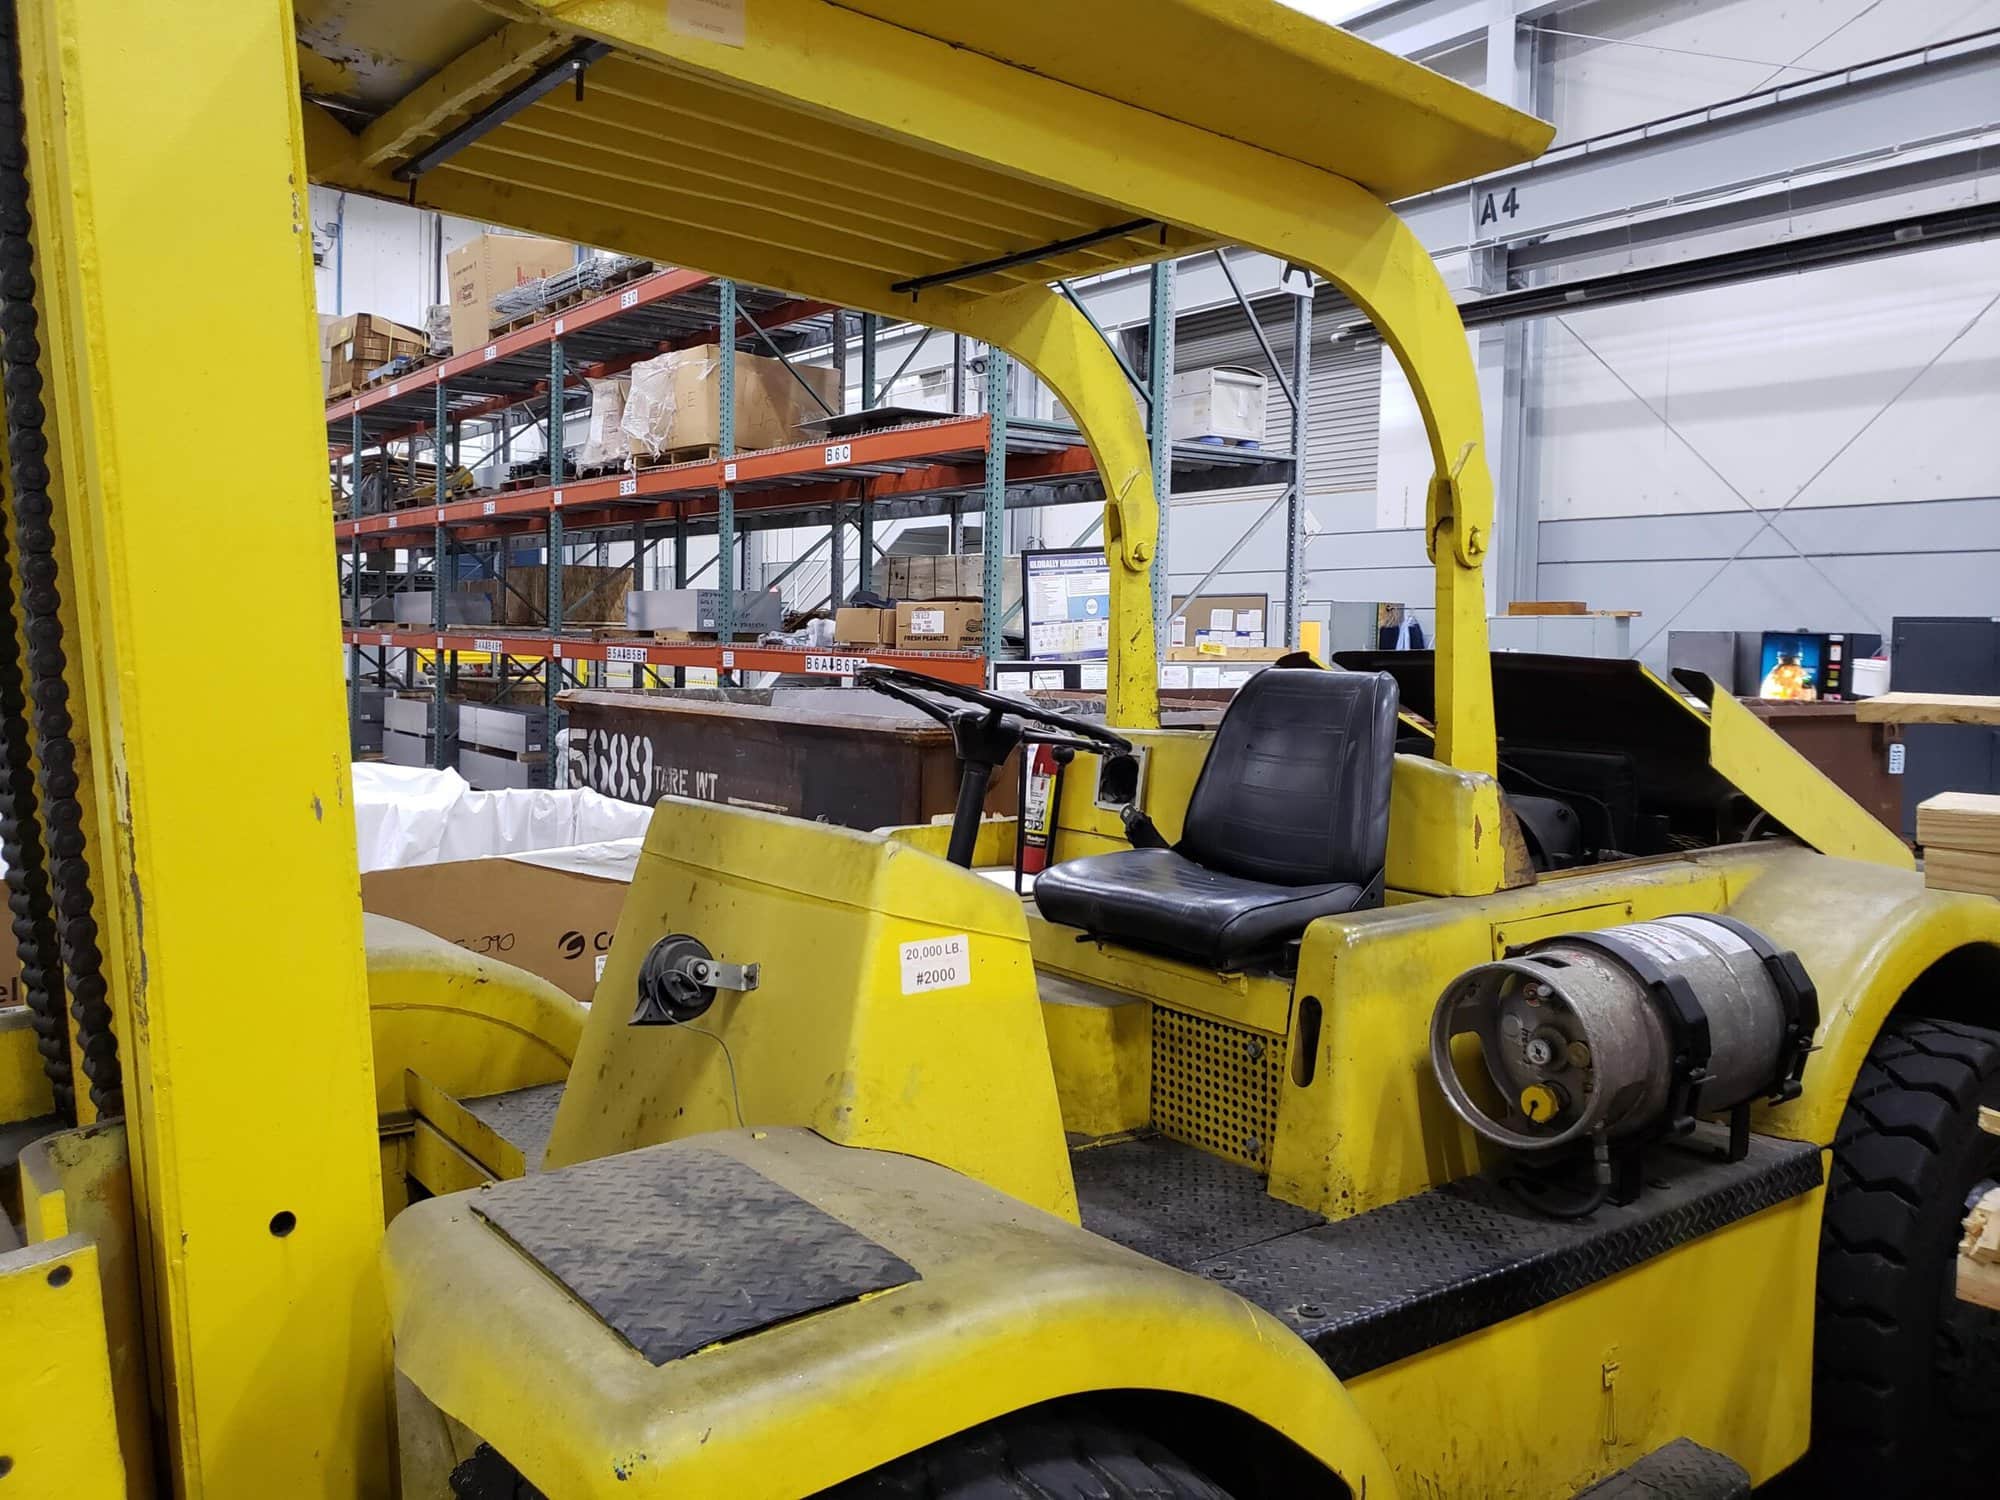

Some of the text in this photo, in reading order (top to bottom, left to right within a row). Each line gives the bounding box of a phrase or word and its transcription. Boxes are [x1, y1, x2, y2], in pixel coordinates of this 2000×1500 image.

[827, 446, 849, 462] B6C
[654, 765, 689, 796] TARE
[696, 770, 719, 800] WT
[905, 944, 943, 960] 20,000
[916, 967, 956, 986] #2000
